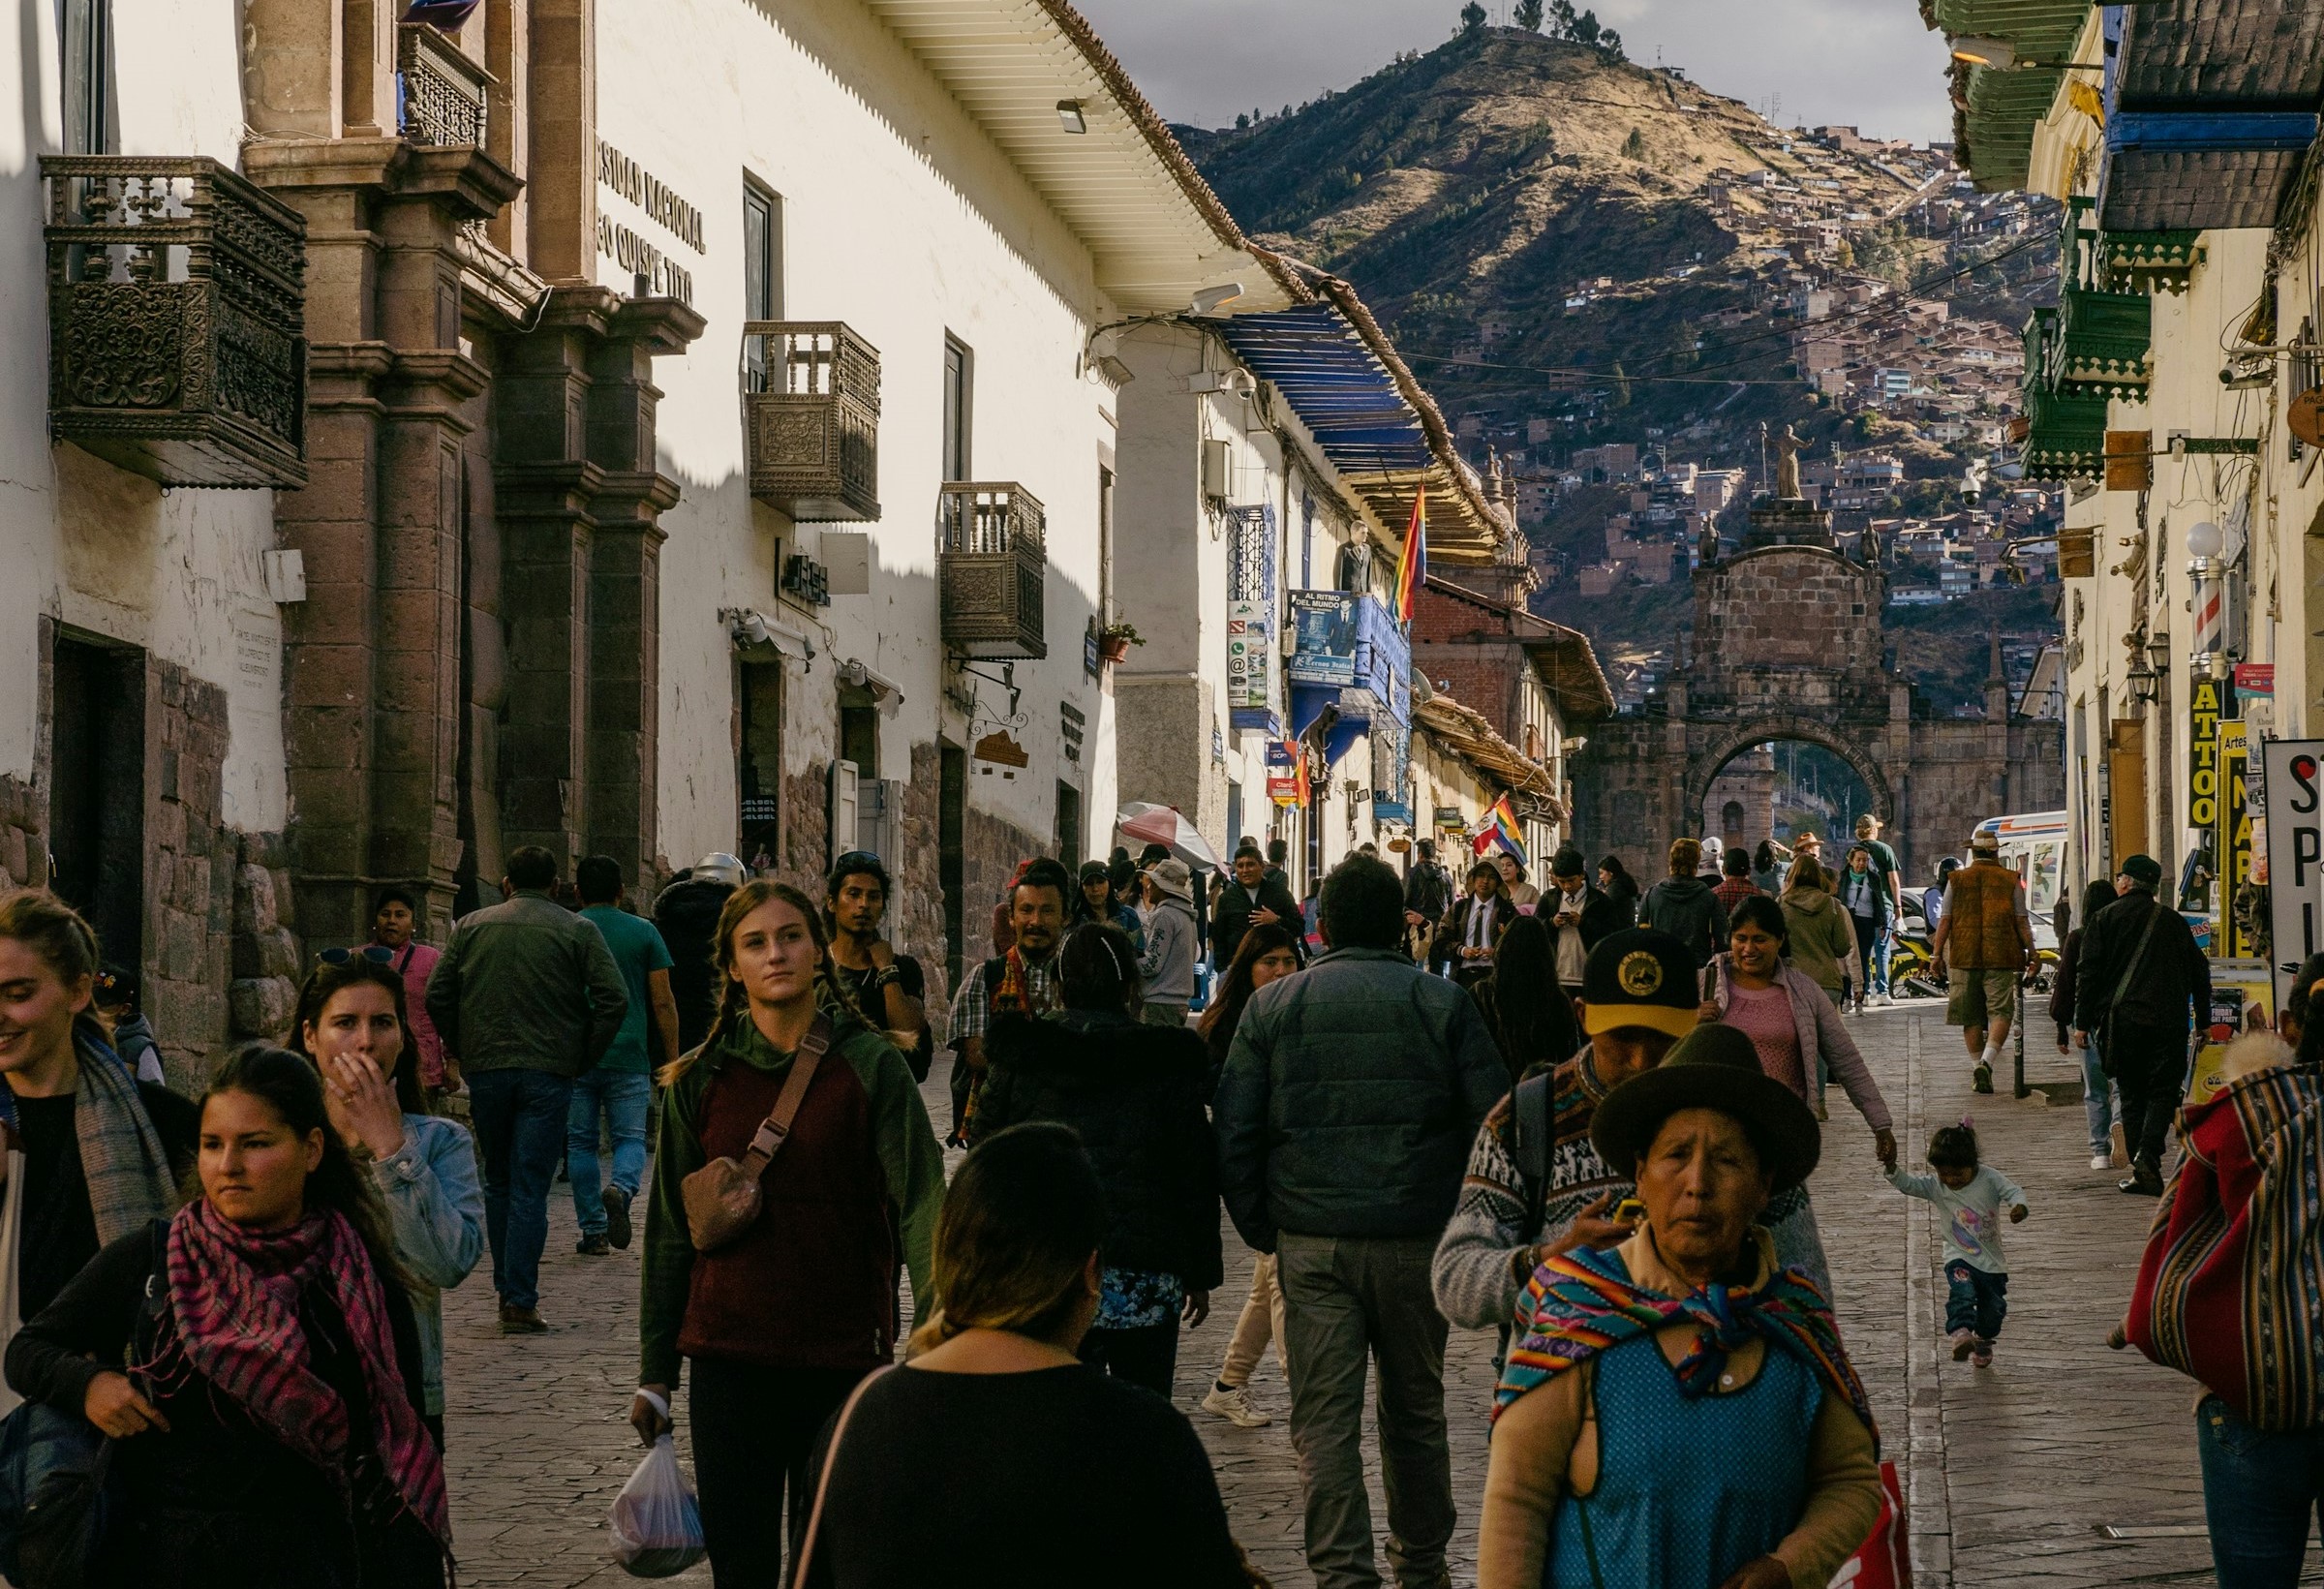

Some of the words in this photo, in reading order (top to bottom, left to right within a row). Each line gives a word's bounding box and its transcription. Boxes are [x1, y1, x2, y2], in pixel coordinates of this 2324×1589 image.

[644, 171, 706, 255] NACIONAL
[616, 223, 663, 293] QUISPE
[664, 257, 693, 310] TITO
[2192, 680, 2218, 824] ATTOO
[2224, 735, 2247, 750] Artes
[2211, 1008, 2233, 1017] FRIDAY
